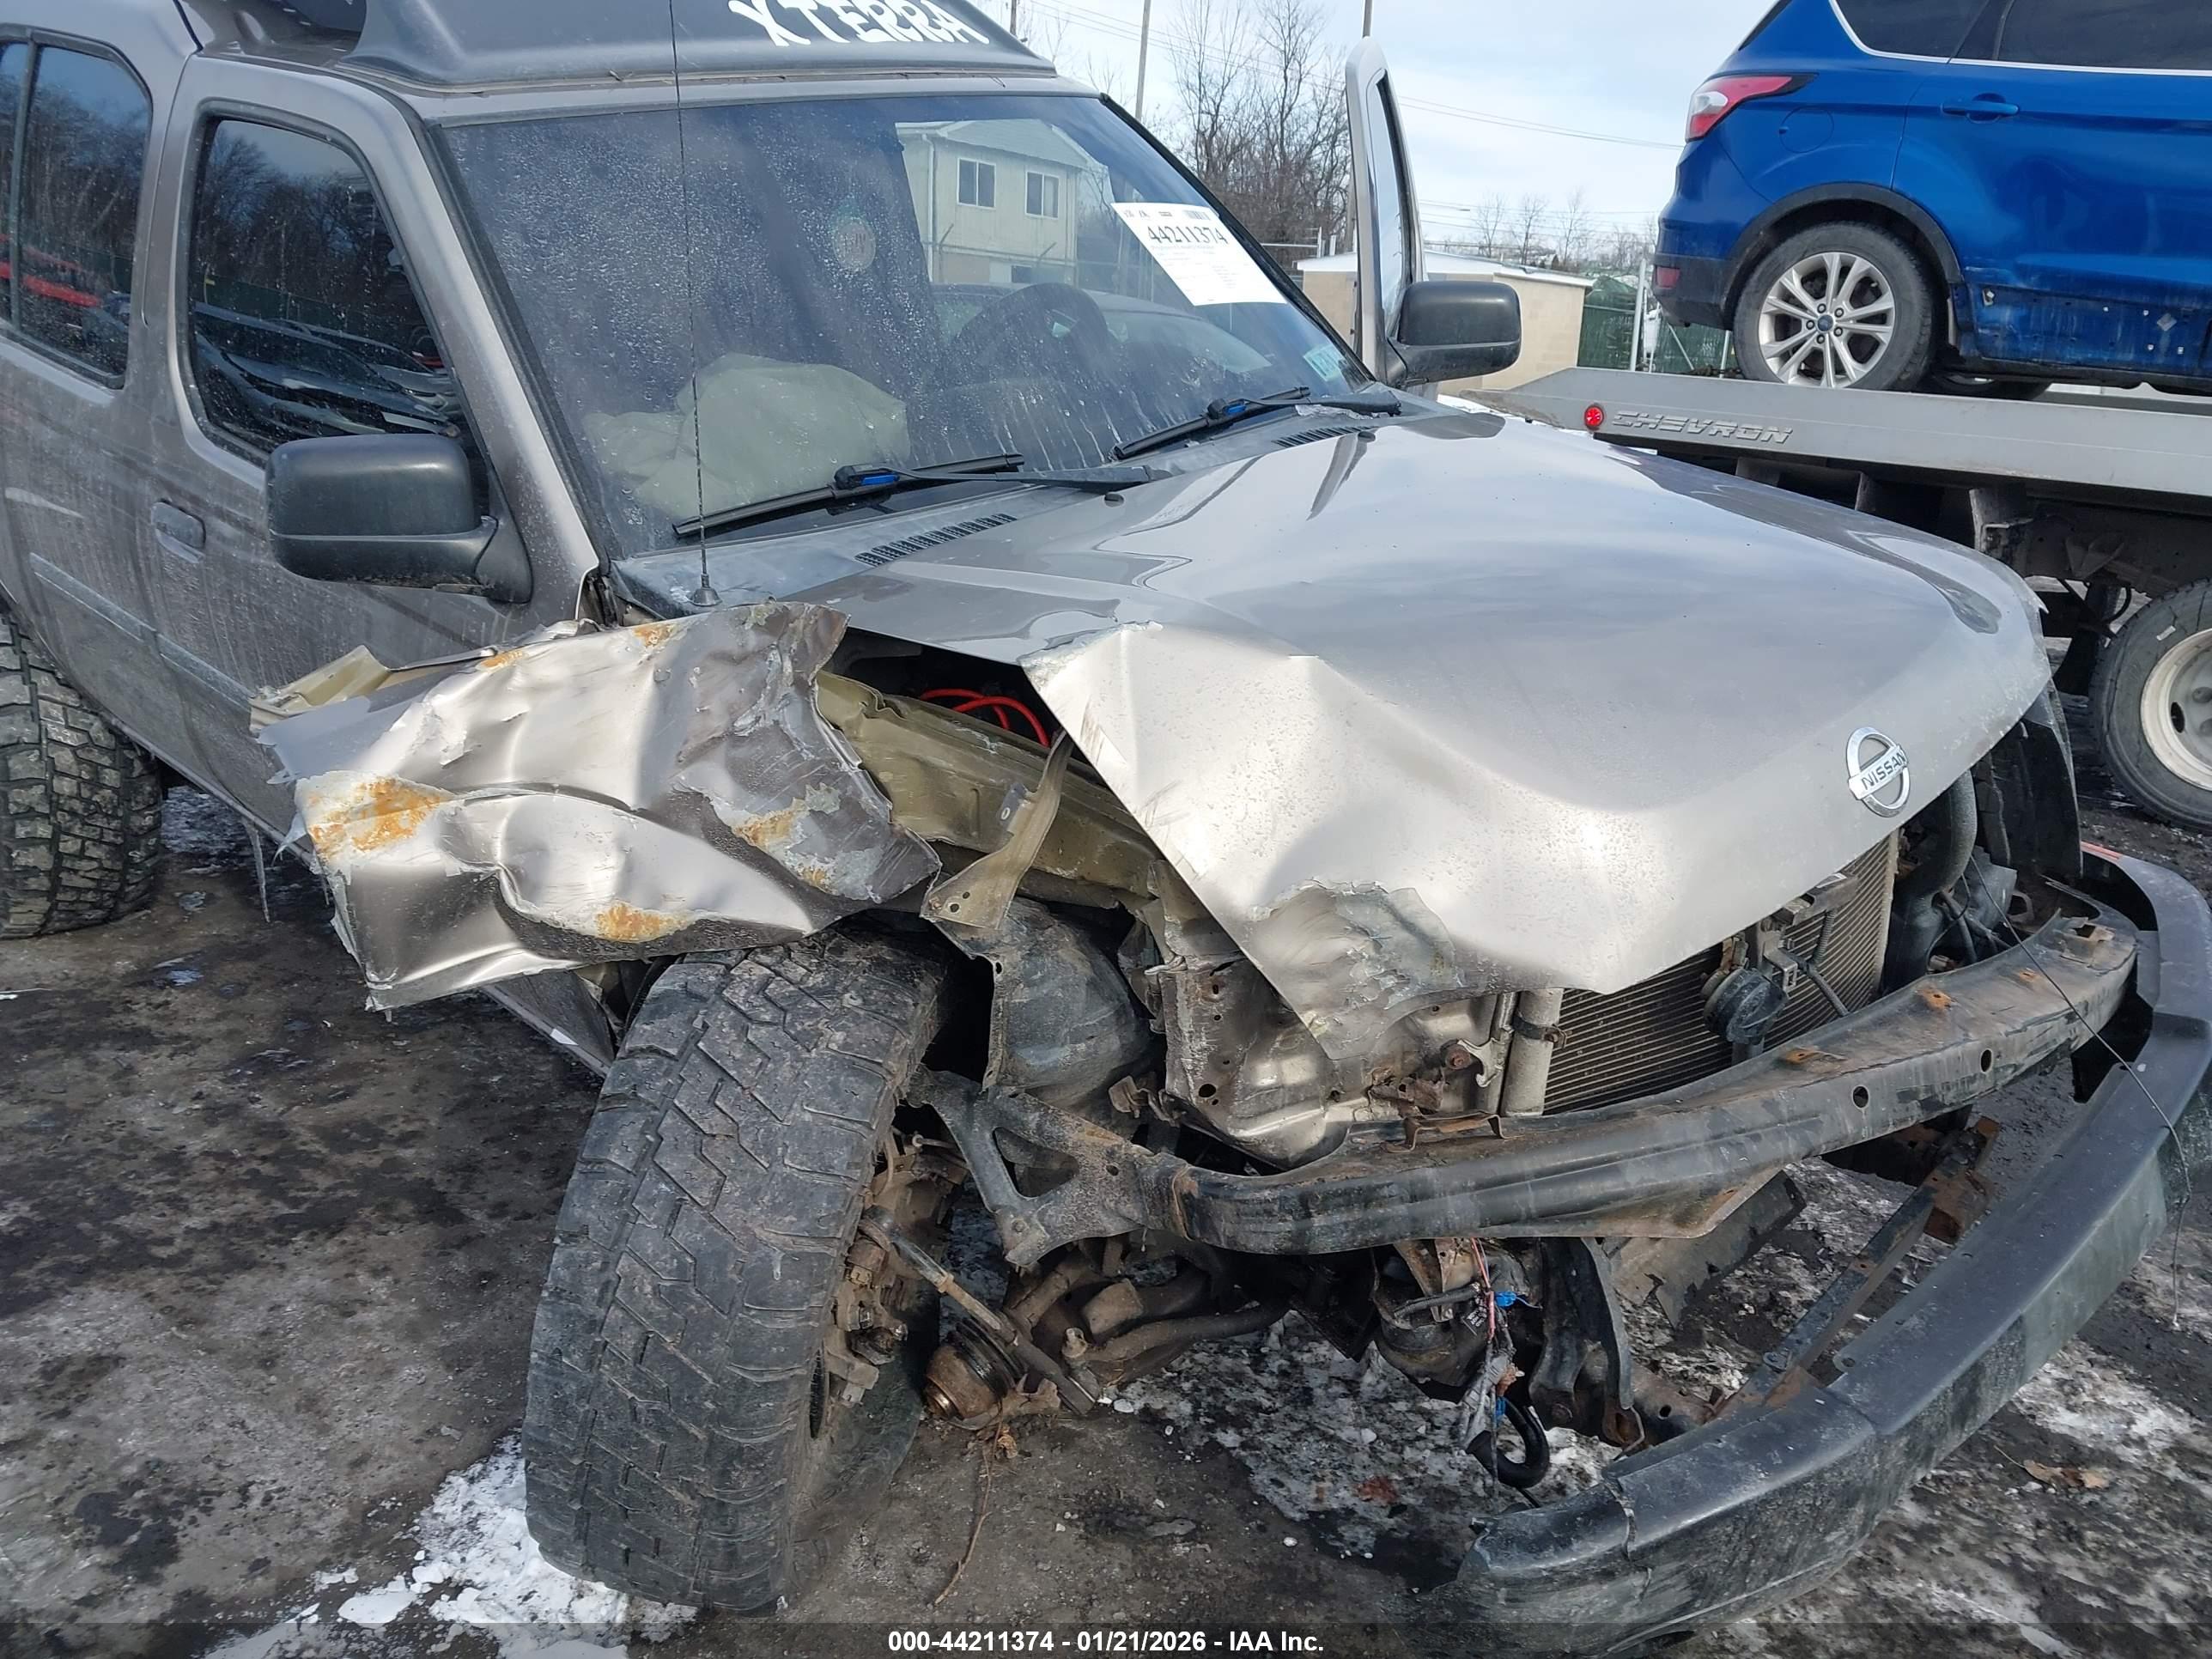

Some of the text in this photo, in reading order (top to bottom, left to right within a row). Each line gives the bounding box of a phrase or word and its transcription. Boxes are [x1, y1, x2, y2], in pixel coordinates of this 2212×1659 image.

[728, 0, 990, 46] XTERRA
[1147, 226, 1229, 244] 44211374
[1612, 411, 1794, 444] CHEVRON
[1861, 751, 1907, 791] NISSAN
